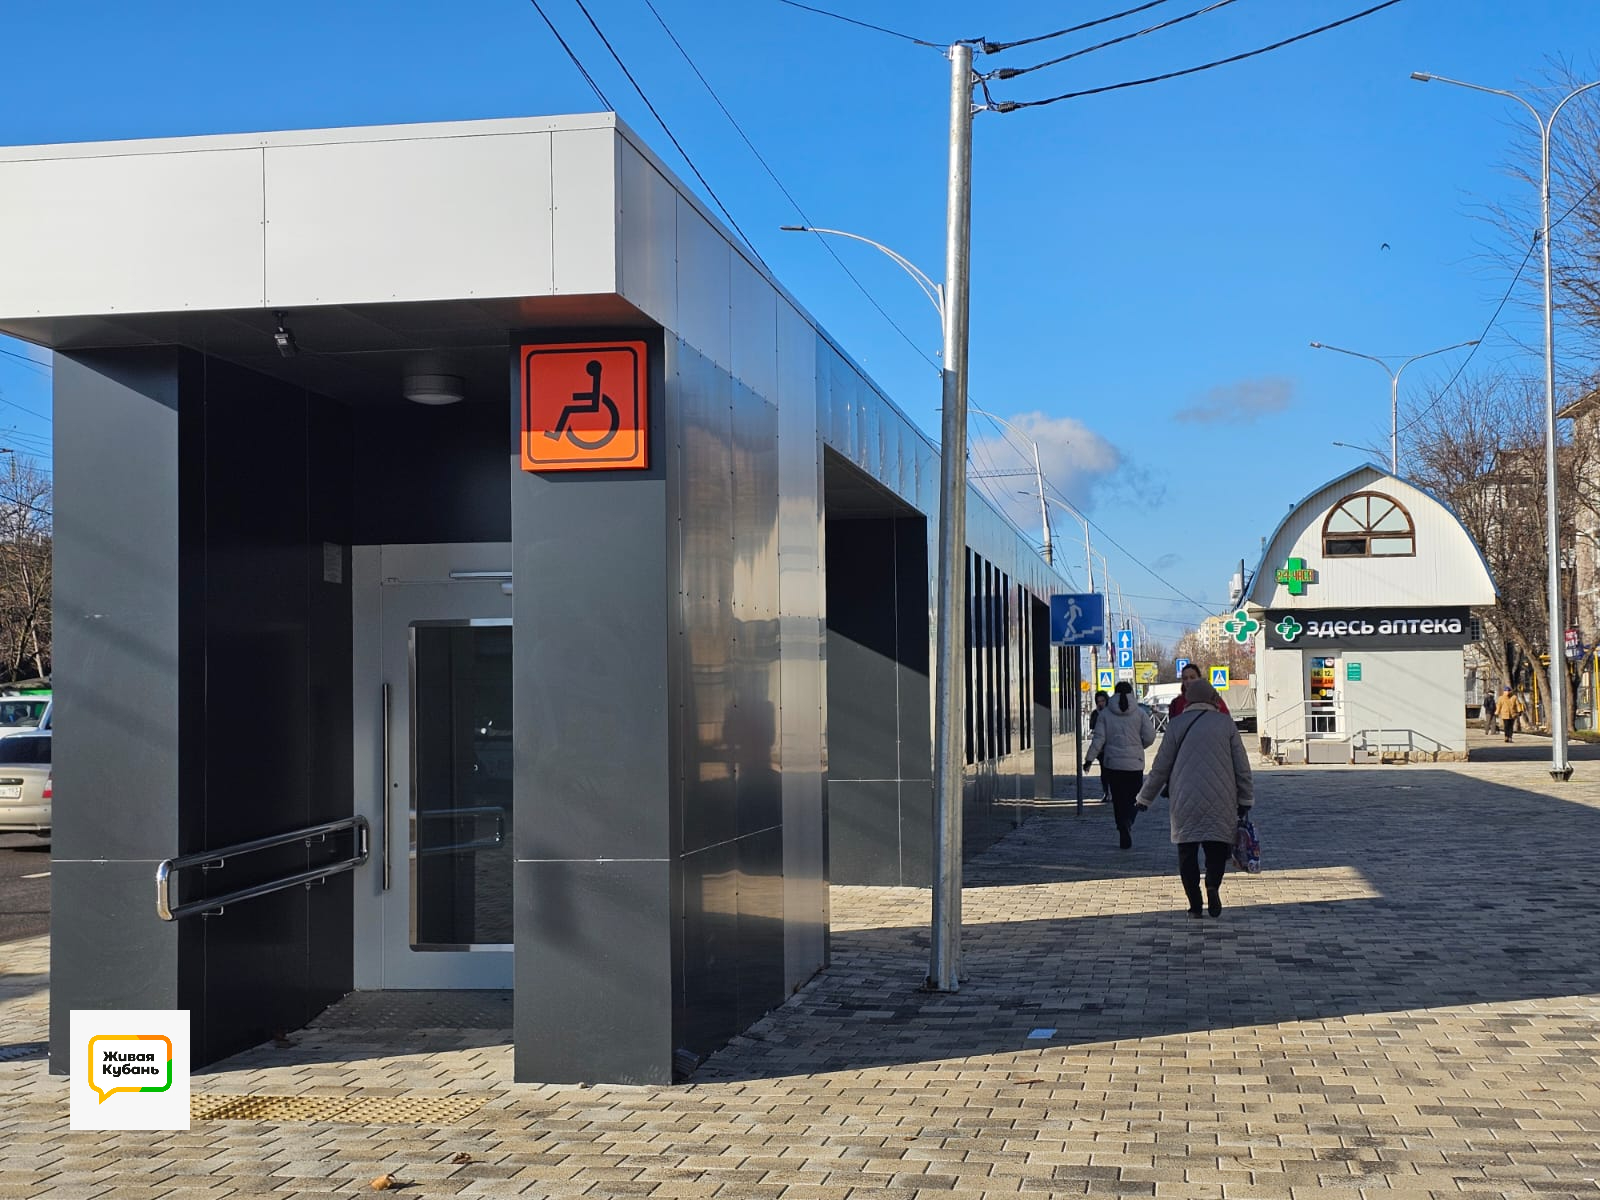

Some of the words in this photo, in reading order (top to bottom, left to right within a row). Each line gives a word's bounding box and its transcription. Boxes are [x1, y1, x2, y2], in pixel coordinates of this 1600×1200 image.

[1306, 620, 1374, 638] здесь
[1378, 618, 1462, 635] аптека
[1121, 652, 1130, 667] P
